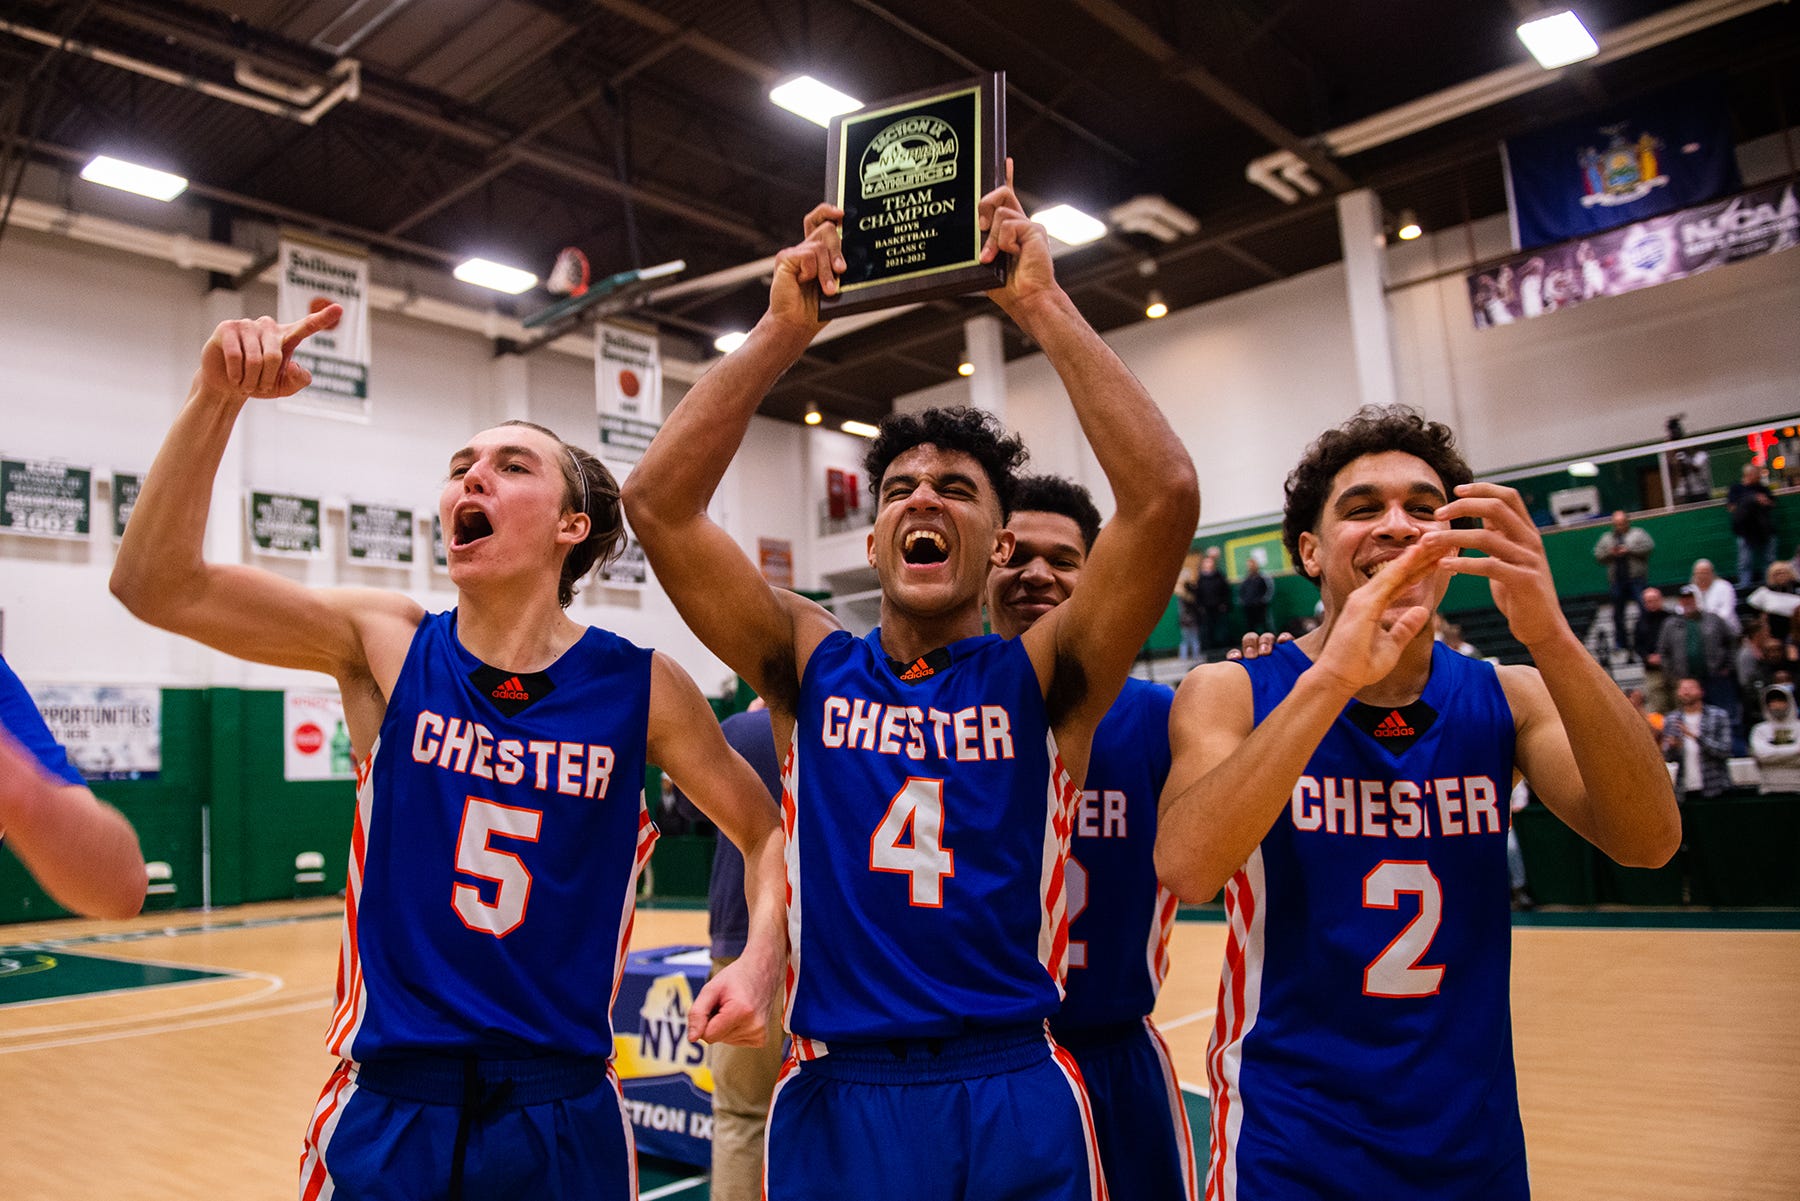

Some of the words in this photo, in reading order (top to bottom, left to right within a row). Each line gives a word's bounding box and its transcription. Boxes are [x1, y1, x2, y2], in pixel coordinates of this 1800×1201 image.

[872, 119, 931, 153] SECTION
[882, 189, 932, 211] TEAM
[859, 198, 956, 231] CHAMPION
[875, 228, 938, 249] BASKETBALL
[893, 221, 919, 234] BOYS
[885, 252, 927, 268] 2021-2022
[886, 244, 916, 258] CLASS
[918, 242, 926, 251] C
[899, 667, 934, 680] adidas
[492, 690, 529, 700] adidas
[40, 704, 152, 726] PPORTUNITIES
[822, 695, 1014, 761] CHESTER
[1374, 727, 1415, 737] adidas
[411, 709, 615, 800] CHESTER
[869, 776, 954, 908] 4
[450, 795, 543, 939] 5
[1362, 859, 1446, 998] 2
[689, 1112, 714, 1140] IX
